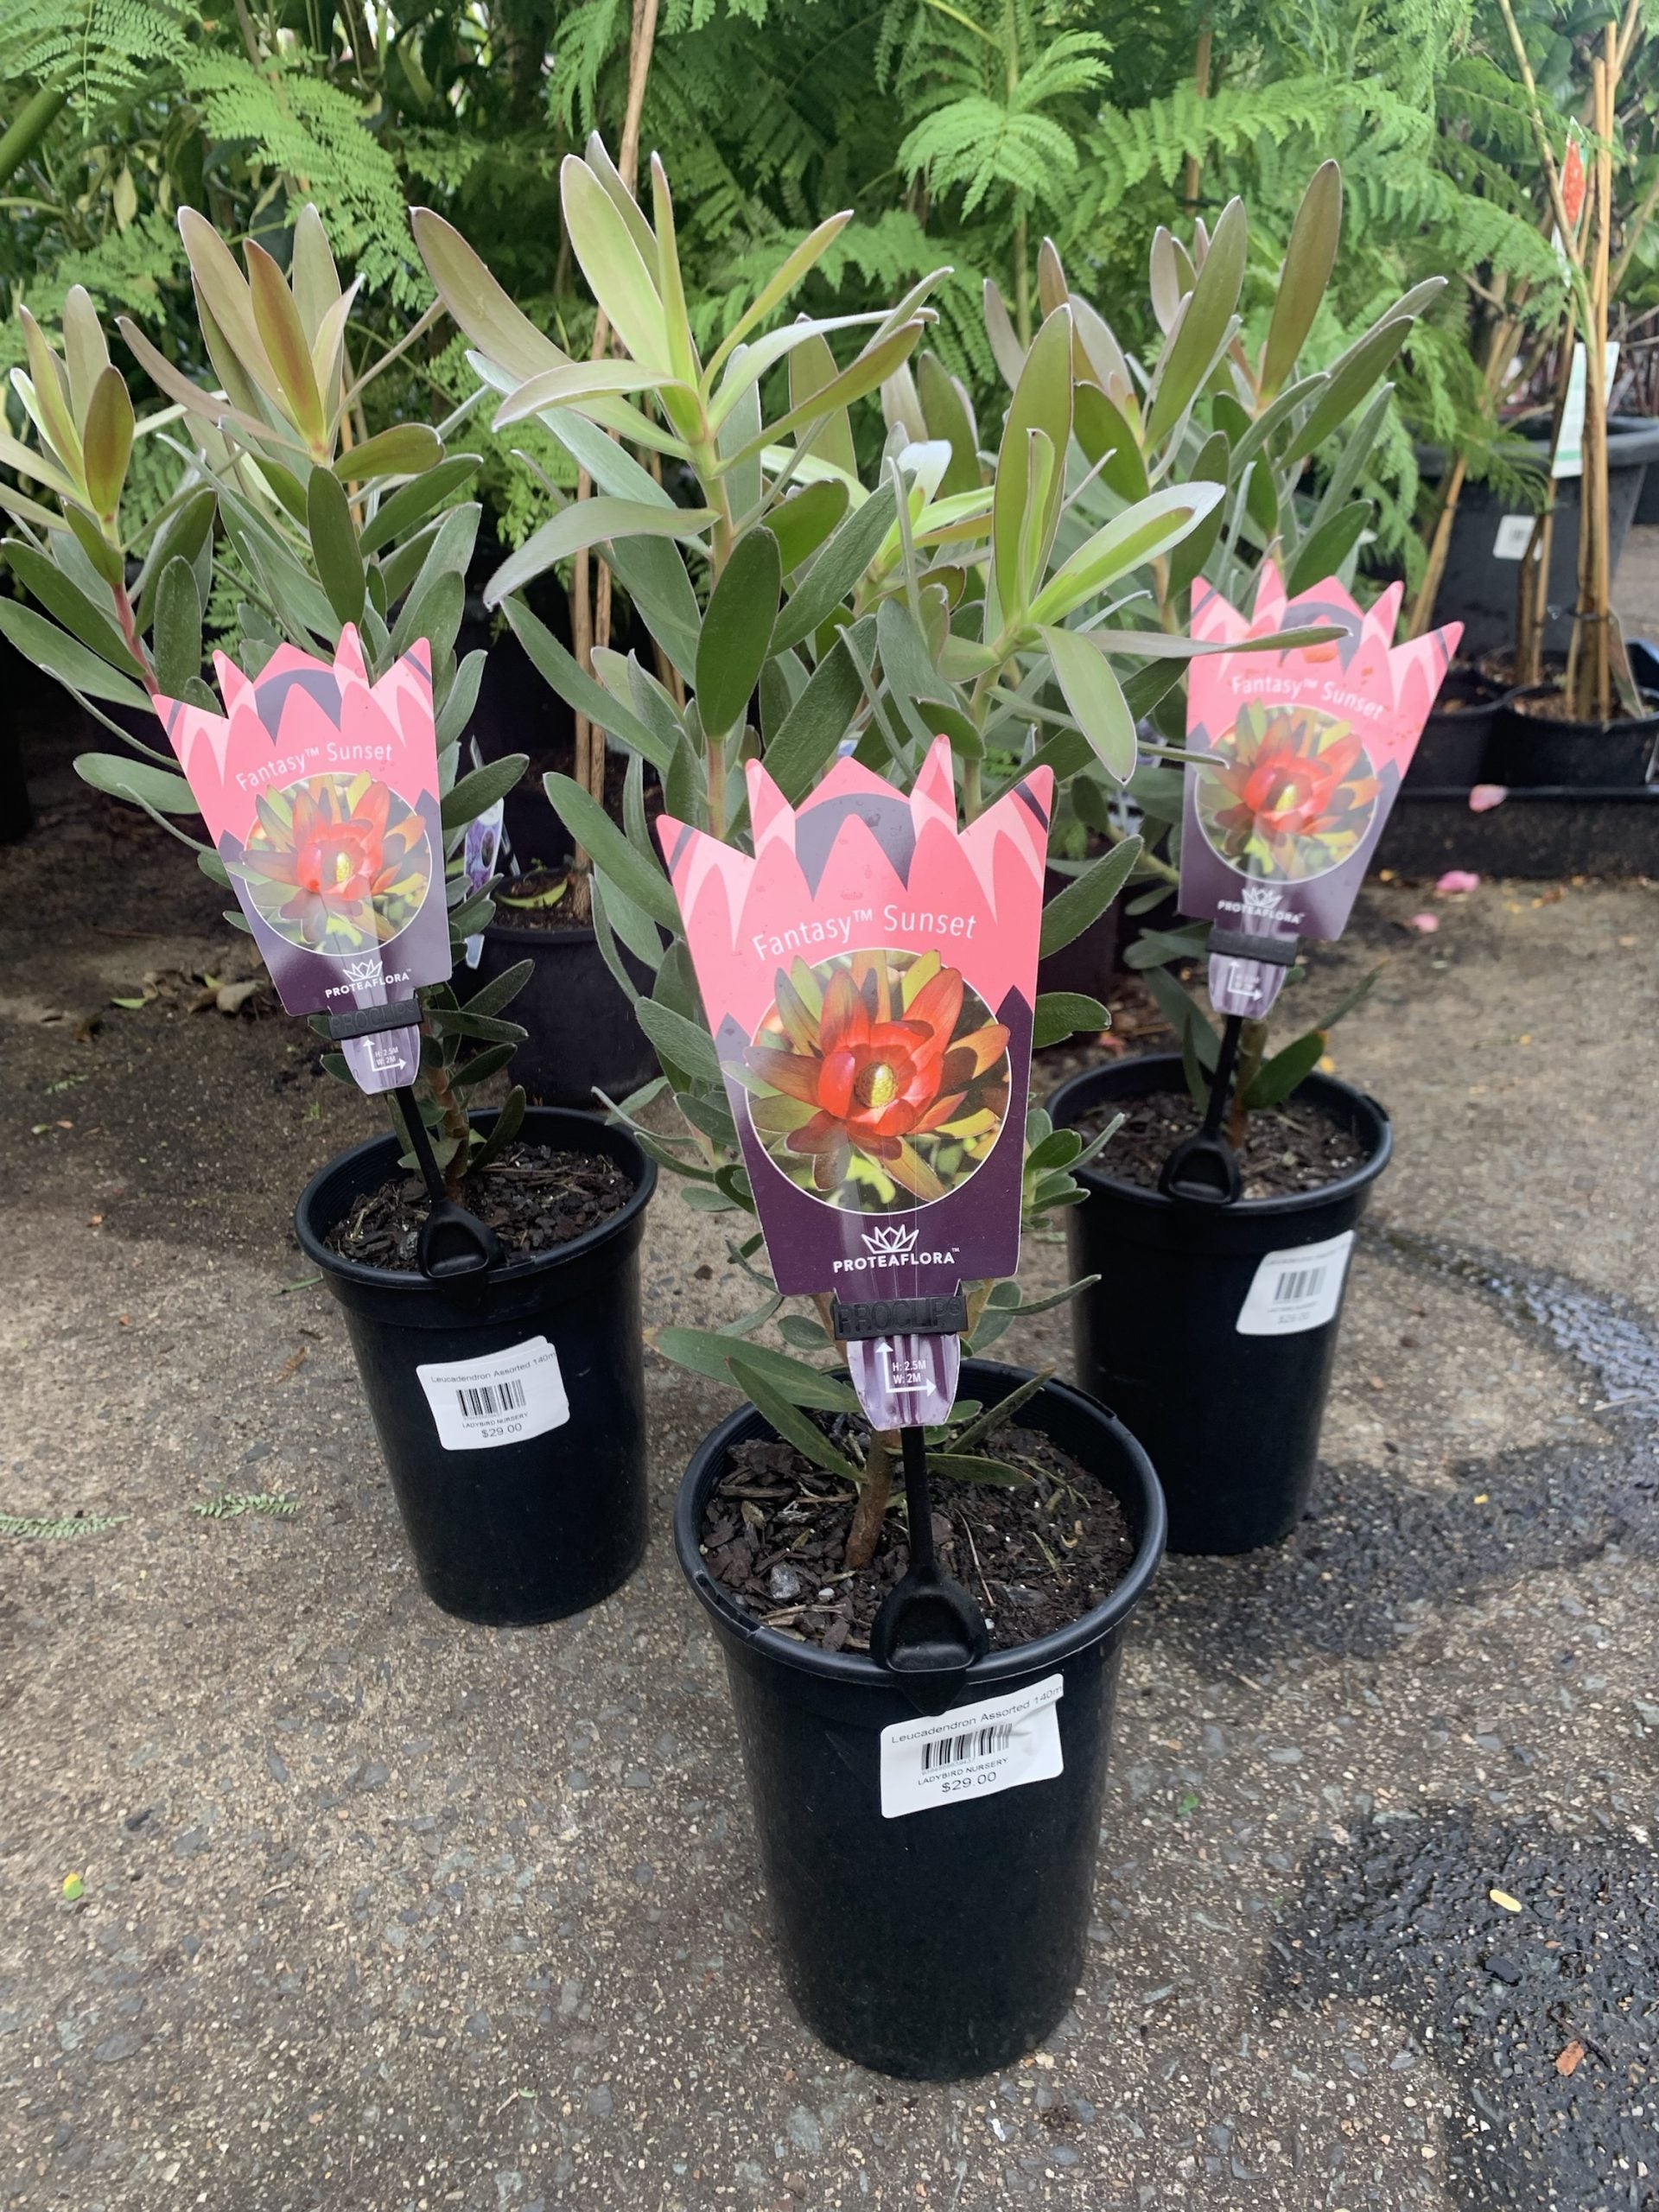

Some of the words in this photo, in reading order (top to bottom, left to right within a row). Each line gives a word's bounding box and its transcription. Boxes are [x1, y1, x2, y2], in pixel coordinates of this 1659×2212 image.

[1321, 681, 1384, 720] Sunset
[327, 741, 392, 761] Sunset
[884, 904, 976, 939] Sunset
[430, 1372, 492, 1383] Leucadendron
[493, 1362, 531, 1377] Assorted
[892, 1362, 903, 1372] H:
[904, 1360, 927, 1371] 2.5M
[893, 1374, 905, 1384] W:
[907, 1373, 922, 1383] 2M
[462, 1420, 496, 1428] LADYBIRD
[497, 1412, 529, 1424] NURSERY
[480, 1423, 523, 1439] $29.00
[891, 1717, 976, 1744] Leucadendron
[980, 1701, 1031, 1721] Assorted
[918, 1769, 963, 1785] LADYBIRD
[965, 1757, 1009, 1773] NURSERY
[941, 1771, 997, 1793] $29.00
